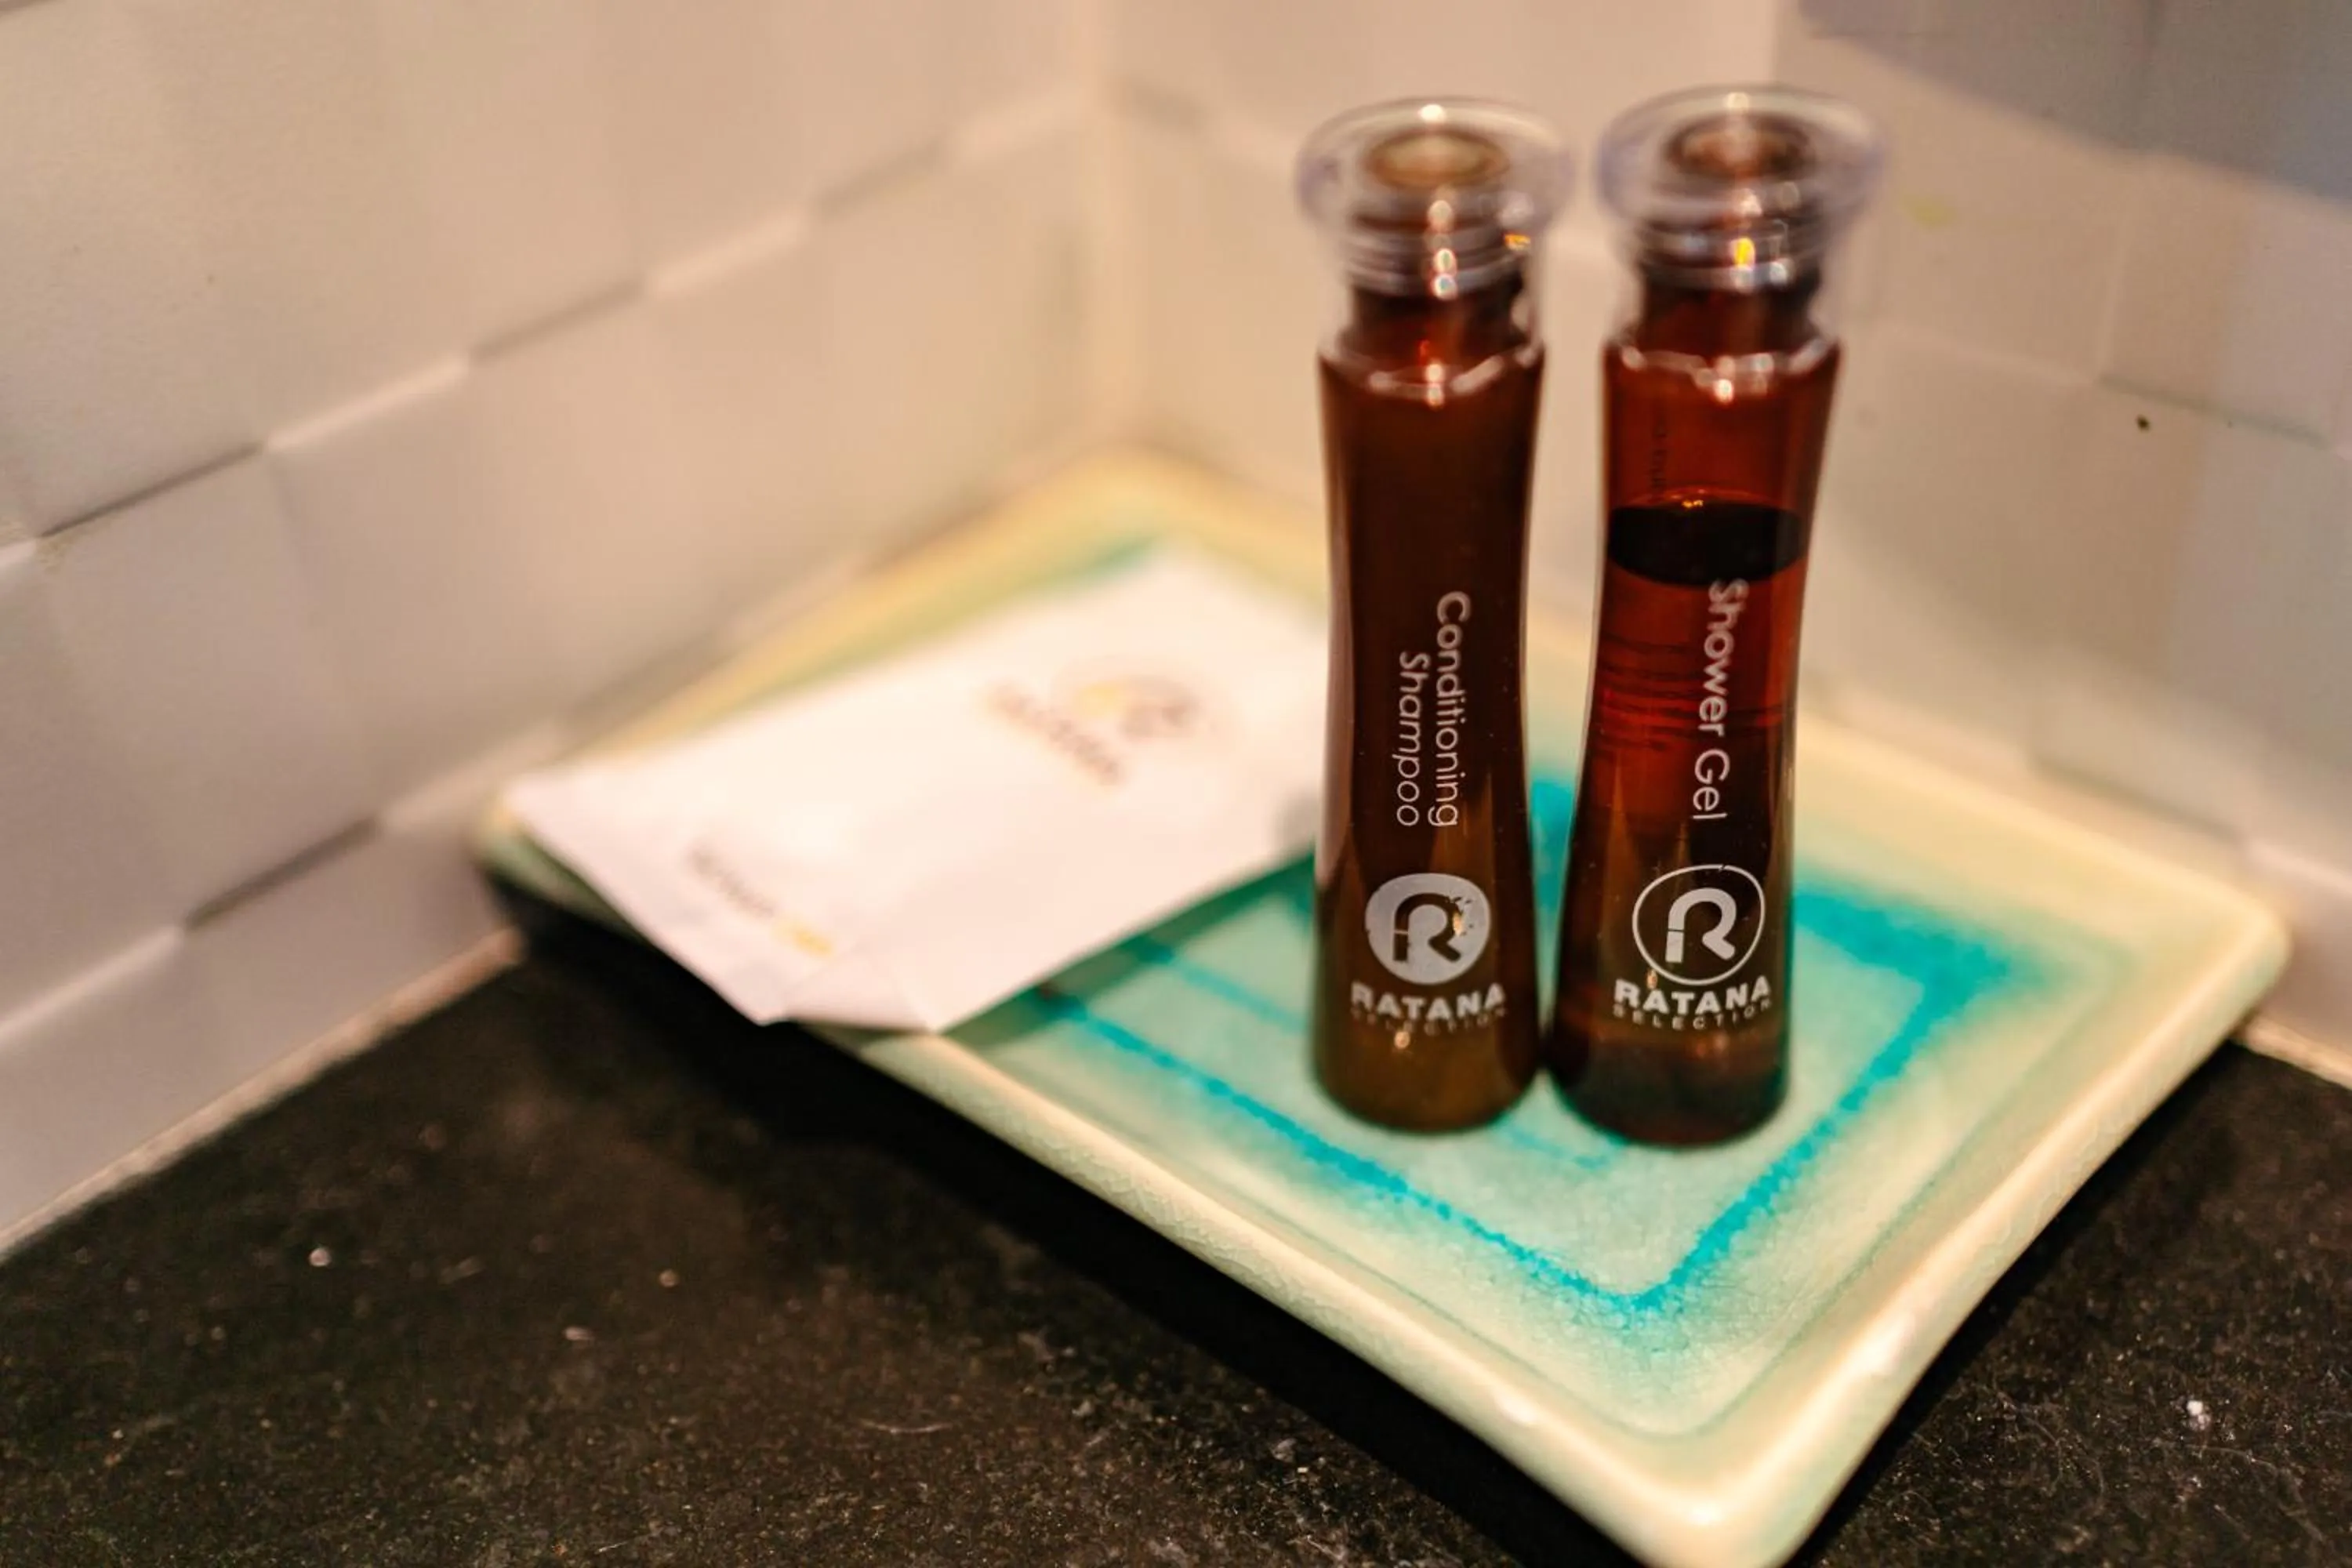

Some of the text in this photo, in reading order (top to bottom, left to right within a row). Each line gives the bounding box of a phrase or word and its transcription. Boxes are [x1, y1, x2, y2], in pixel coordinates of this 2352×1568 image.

[1392, 650, 1432, 827] Shampoo
[1427, 590, 1472, 827] Conditioning
[1691, 578, 1750, 820] Shower Gel
[1350, 982, 1506, 1021] RATANA
[1613, 976, 1771, 1016] RATANA
